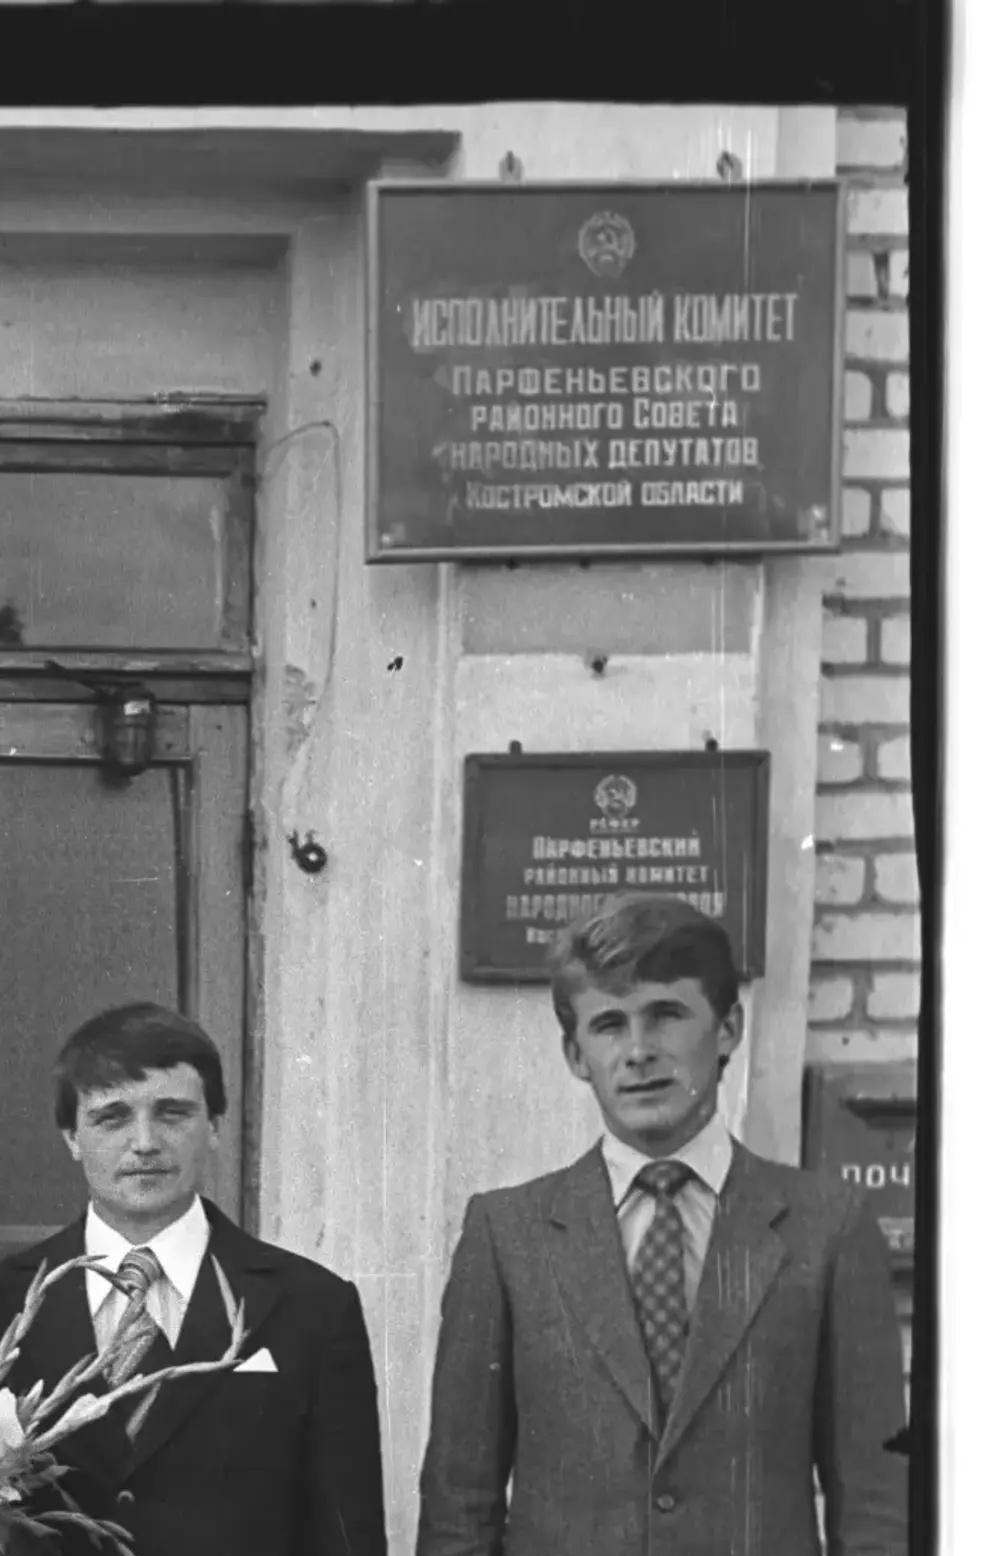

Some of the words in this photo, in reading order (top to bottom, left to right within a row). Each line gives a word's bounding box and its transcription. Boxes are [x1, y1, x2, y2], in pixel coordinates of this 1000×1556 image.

[411, 289, 664, 346] ИСПОЛНИТЕЛЬНЫЙ
[673, 294, 798, 342] КОМИТЕТ
[452, 364, 761, 394] ПАРФЕНЬЕВСКОГО
[471, 401, 622, 431] РАЙОННОГО
[450, 439, 599, 471] НАРОДНЫХ
[608, 438, 758, 469] ДЕПУТАТОВ
[466, 480, 631, 509] КОСТРОМСКОЙ
[641, 480, 744, 506] ОБЛАСТИ
[626, 865, 709, 884] КОМИТЕТ
